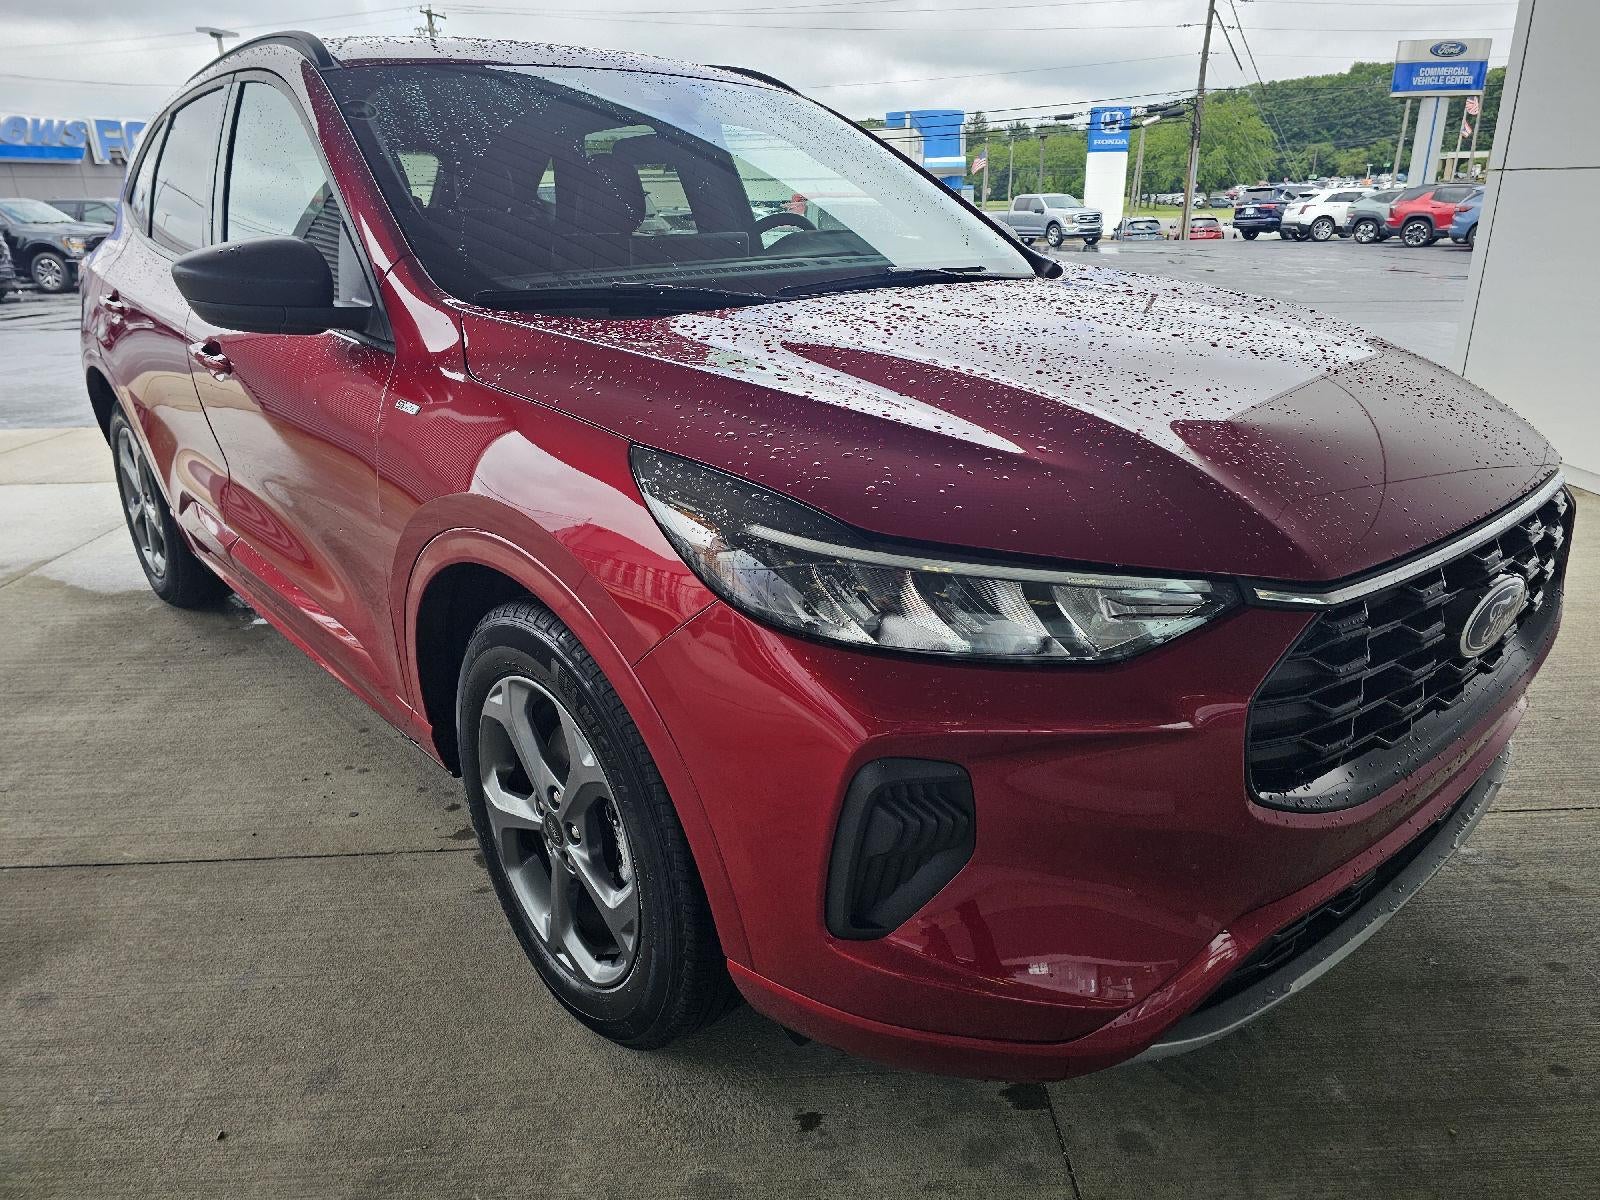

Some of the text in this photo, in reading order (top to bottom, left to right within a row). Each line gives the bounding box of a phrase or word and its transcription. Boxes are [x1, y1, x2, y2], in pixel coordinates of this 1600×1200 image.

[1438, 43, 1461, 55] Ford
[1419, 67, 1469, 76] COMMERCIAL
[1413, 76, 1474, 86] VEHICLE CENTER
